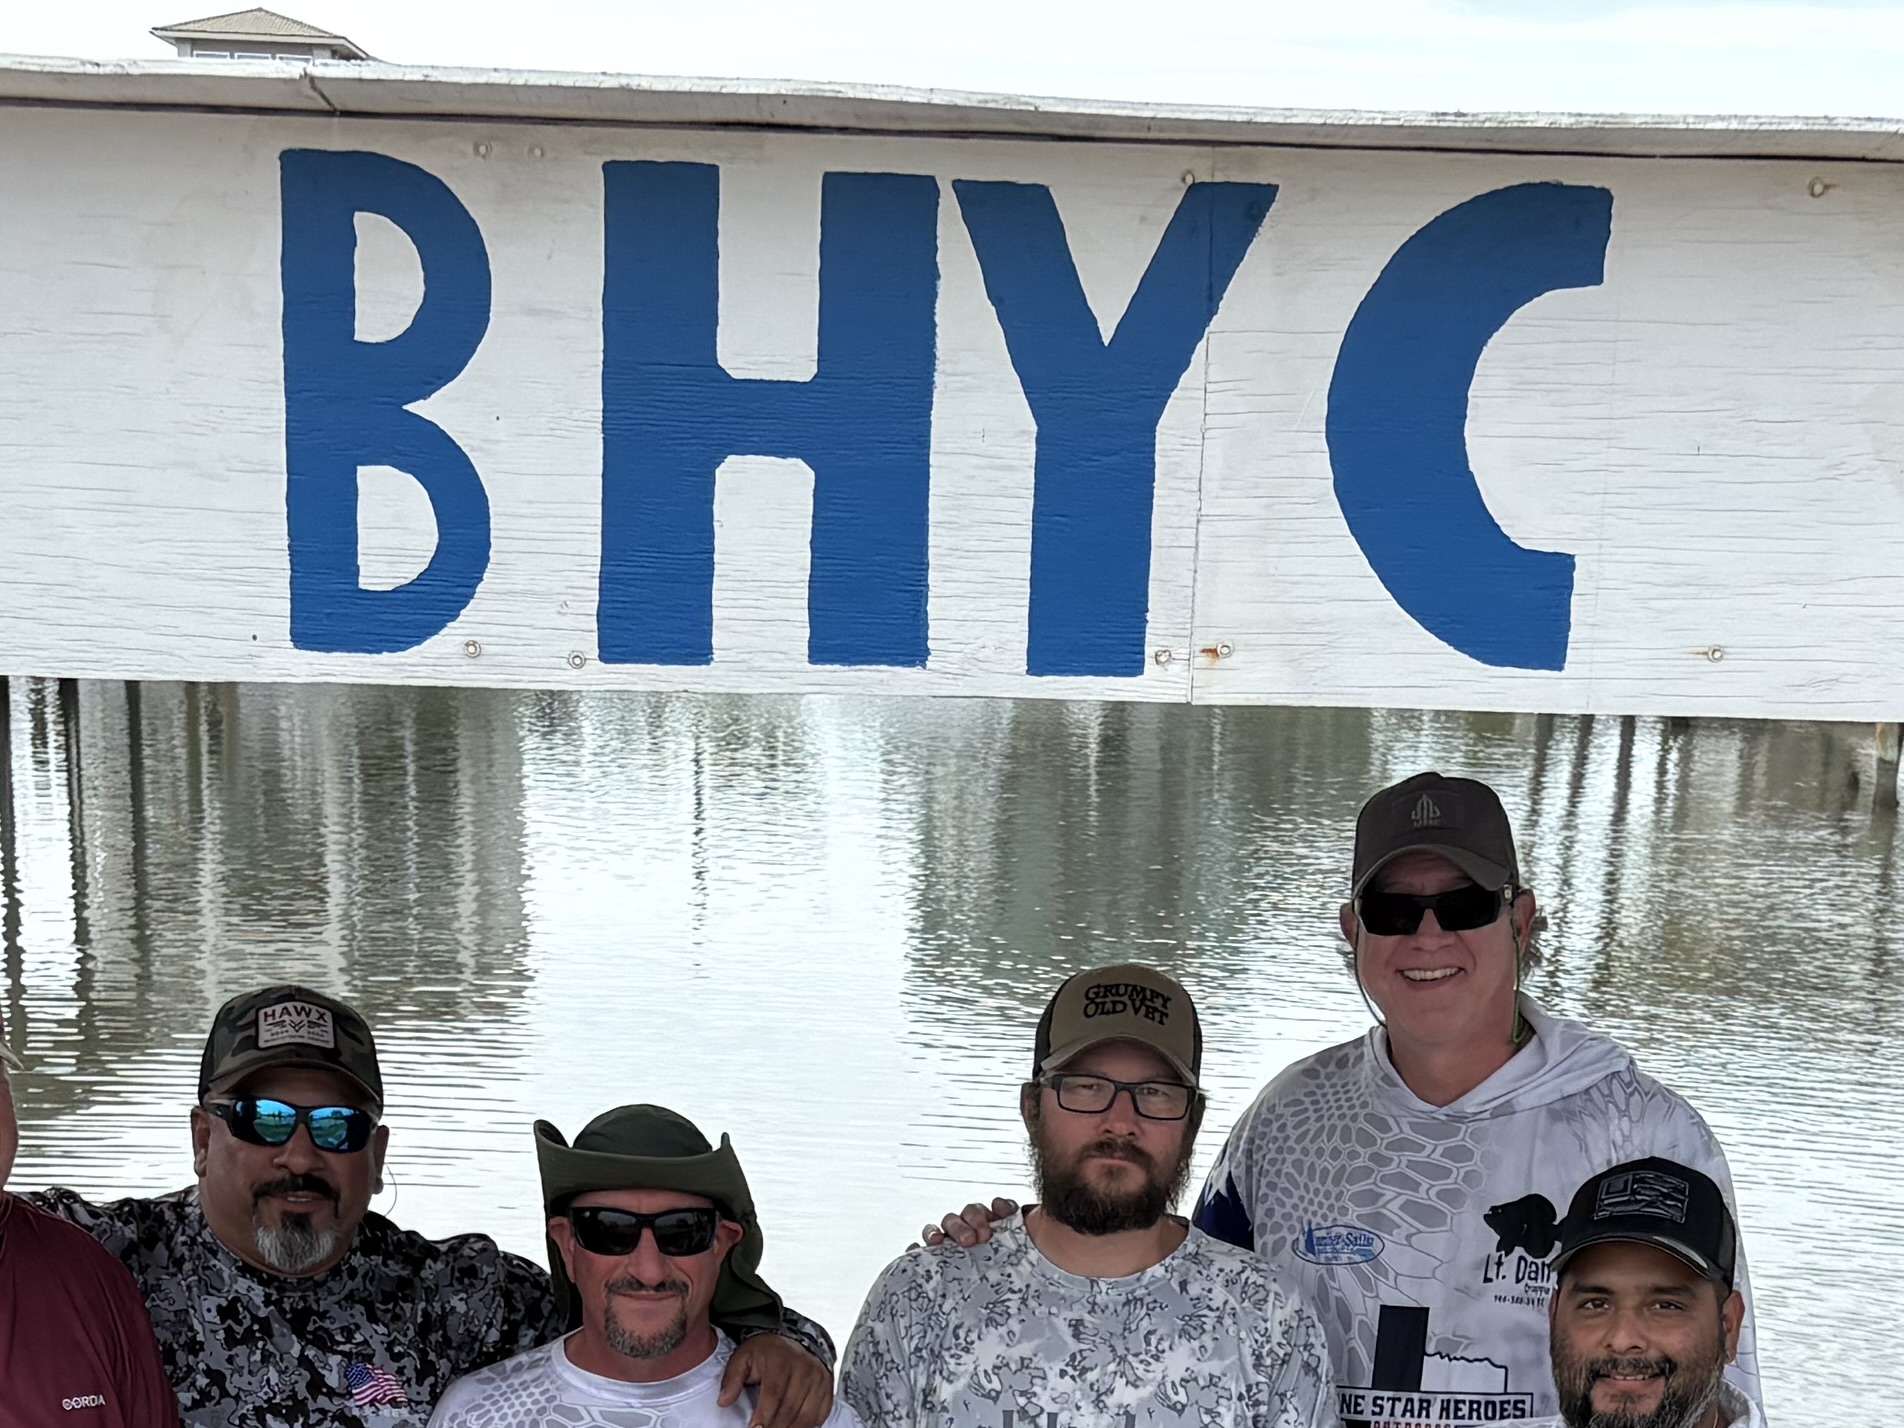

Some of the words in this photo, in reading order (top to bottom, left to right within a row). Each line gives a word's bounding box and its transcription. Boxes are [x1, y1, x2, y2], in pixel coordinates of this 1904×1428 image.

[279, 148, 1615, 678] BHYC
[1084, 983, 1172, 1010] GRUMPY
[263, 1005, 328, 1024] HAWX
[1083, 1000, 1128, 1019] OLD
[1129, 998, 1170, 1026] VET
[1482, 1253, 1507, 1284] Lt.
[1515, 1254, 1551, 1285] Dan
[1339, 1392, 1366, 1416] NE
[1371, 1395, 1432, 1419] STAR
[1439, 1398, 1527, 1421] HEROES
